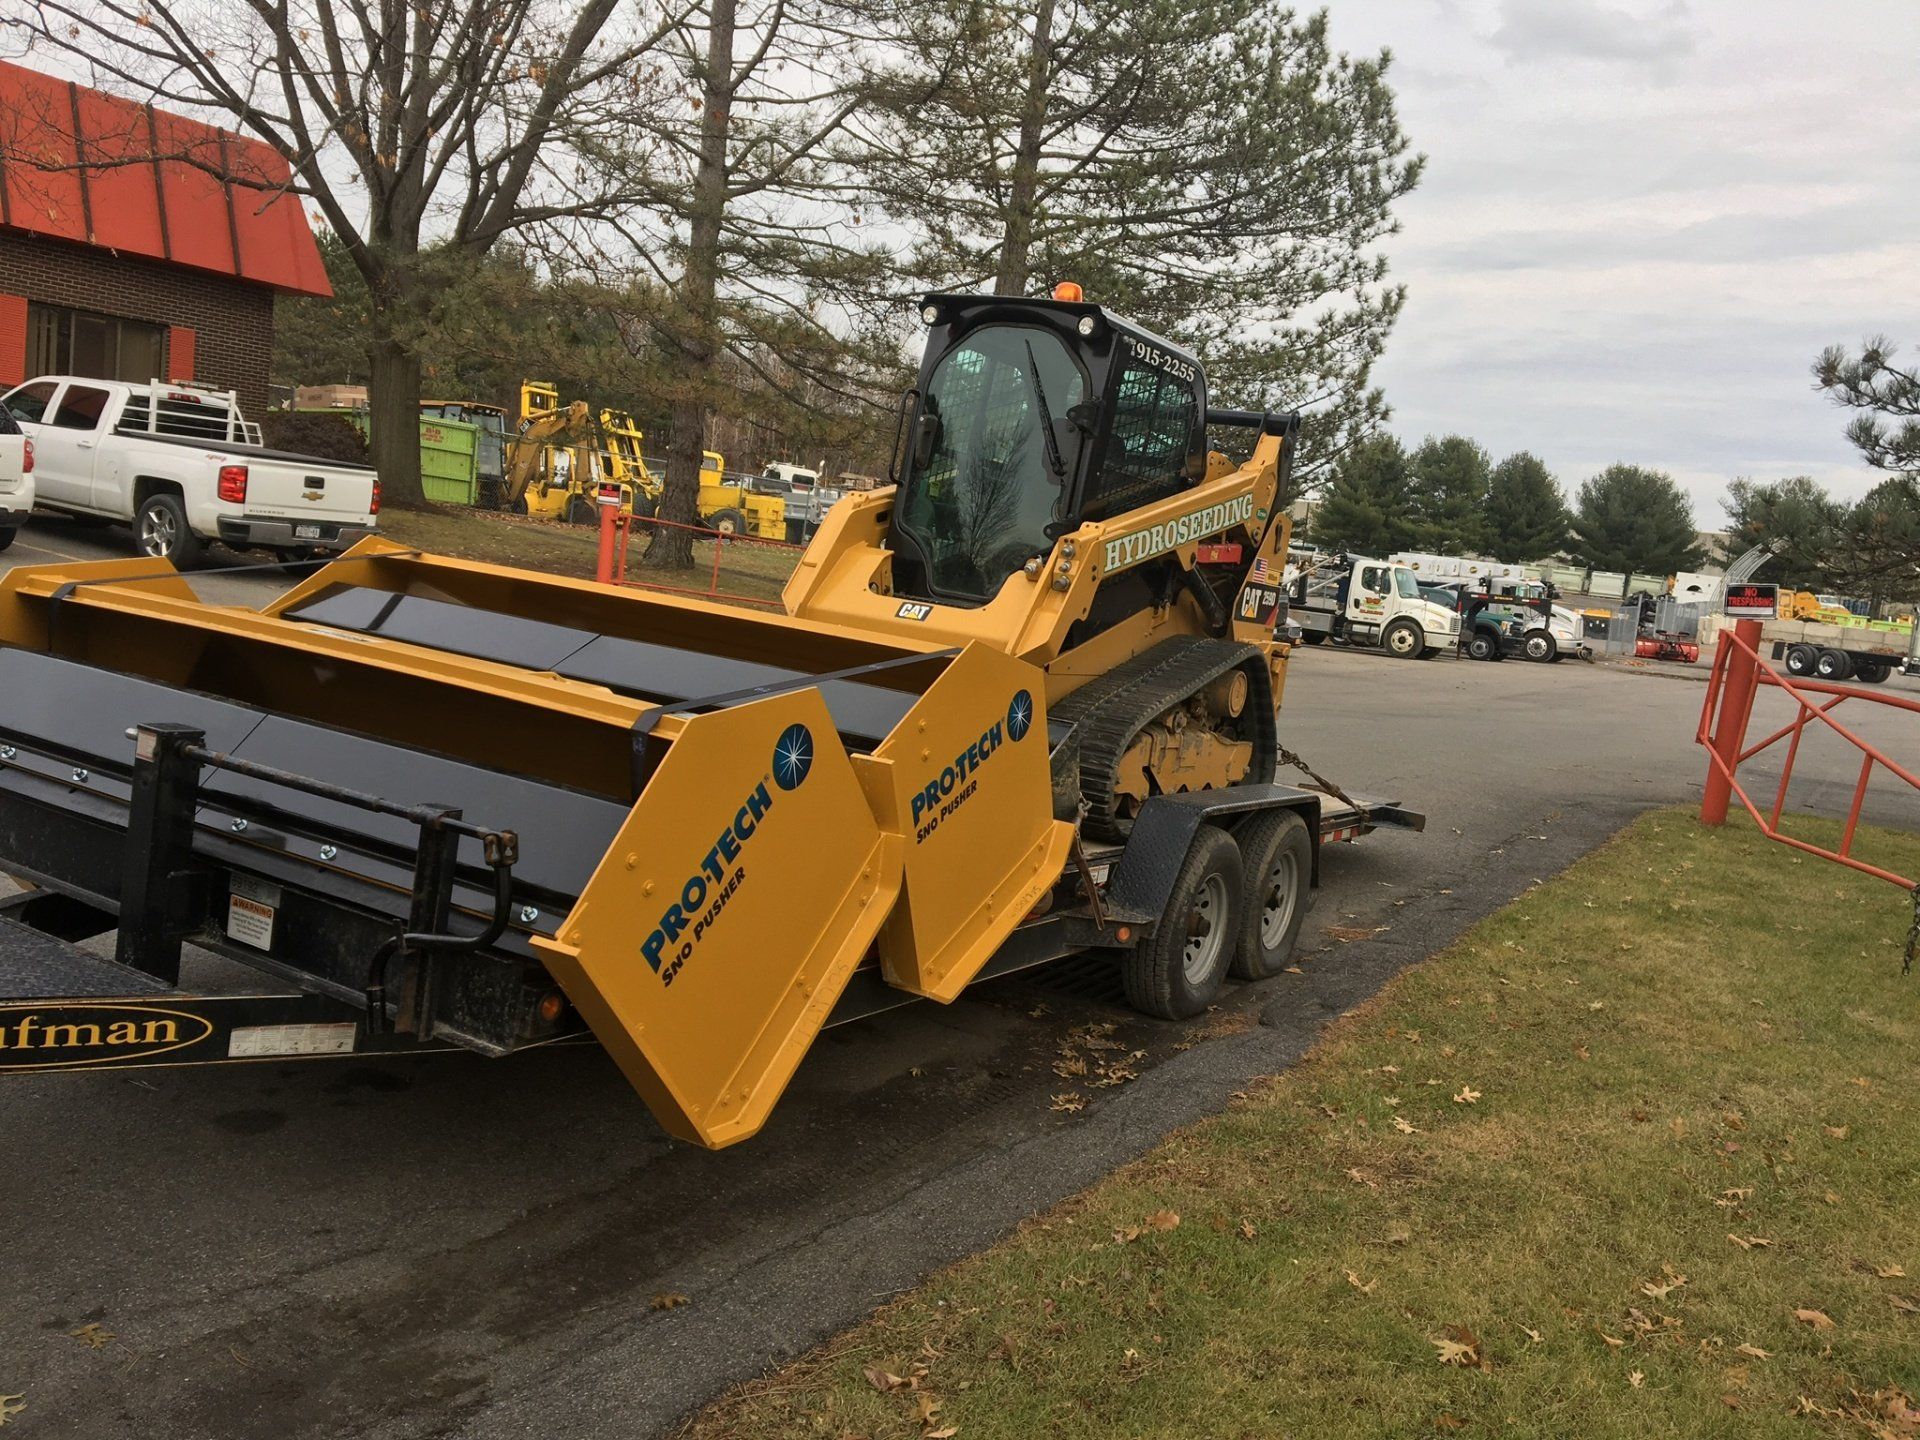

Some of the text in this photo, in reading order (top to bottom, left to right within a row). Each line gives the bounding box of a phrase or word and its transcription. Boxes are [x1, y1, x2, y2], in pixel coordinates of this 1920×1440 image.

[1136, 342, 1195, 382] 915-2255
[1104, 493, 1253, 572] HYDROSEEDING
[1241, 587, 1262, 618] CAT
[1744, 587, 1758, 597] NO
[899, 603, 930, 620] CAT
[917, 780, 977, 844] SNO PUSHER
[238, 898, 273, 918] WARNING
[661, 866, 746, 987] SNO PUSHER
